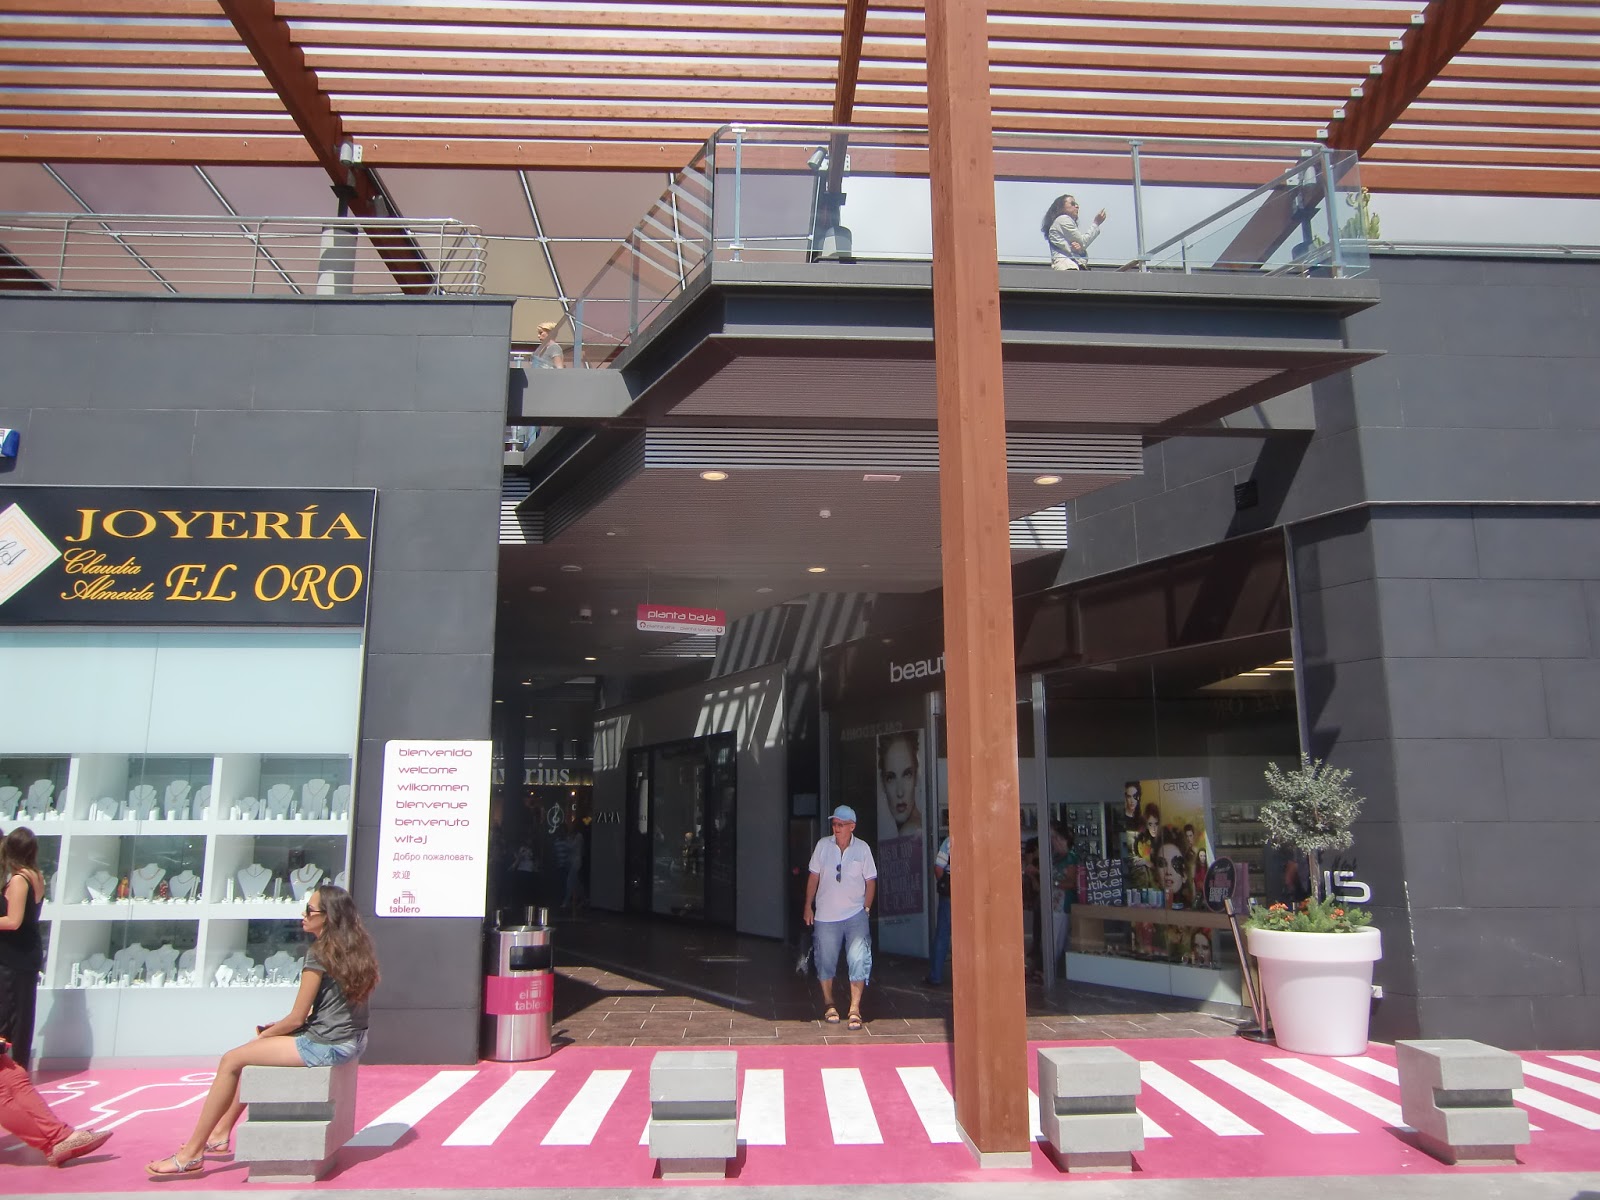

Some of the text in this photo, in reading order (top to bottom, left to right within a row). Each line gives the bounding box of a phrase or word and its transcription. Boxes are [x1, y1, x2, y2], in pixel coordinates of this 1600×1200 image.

[64, 504, 367, 543] JOYERÍA
[62, 547, 142, 576] Claudia
[60, 575, 155, 602] Almeida
[165, 563, 364, 611] EL ORO
[647, 609, 716, 623] planta baja
[398, 748, 473, 757] bienvenido
[398, 765, 458, 775] welcome
[395, 800, 468, 809] bienvenue
[394, 817, 470, 827] benvenuto
[394, 834, 428, 845] witaj
[392, 852, 474, 863] Добро пожаловать
[391, 870, 411, 880] 欢迎
[1323, 870, 1371, 903] 15
[392, 896, 401, 905] el
[389, 905, 421, 914] tablero
[519, 989, 529, 1000] el
